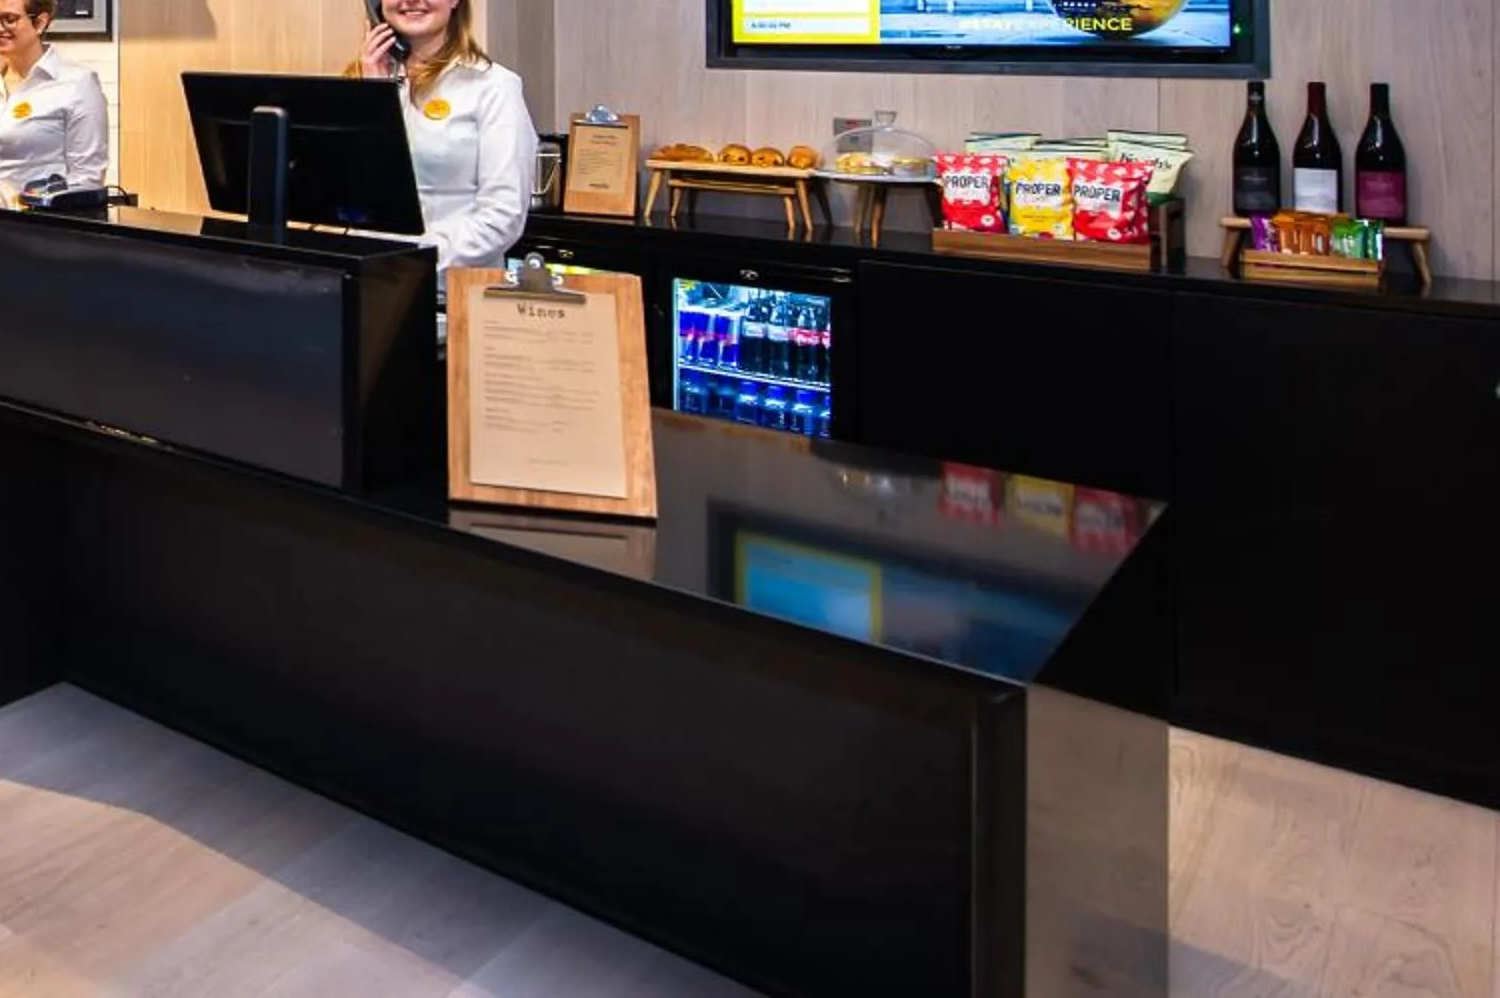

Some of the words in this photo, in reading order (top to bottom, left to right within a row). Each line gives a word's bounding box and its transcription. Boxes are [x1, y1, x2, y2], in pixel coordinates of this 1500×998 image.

[945, 174, 990, 189] PROPER
[1015, 182, 1061, 196] PROPER
[1074, 183, 1121, 202] PROPER
